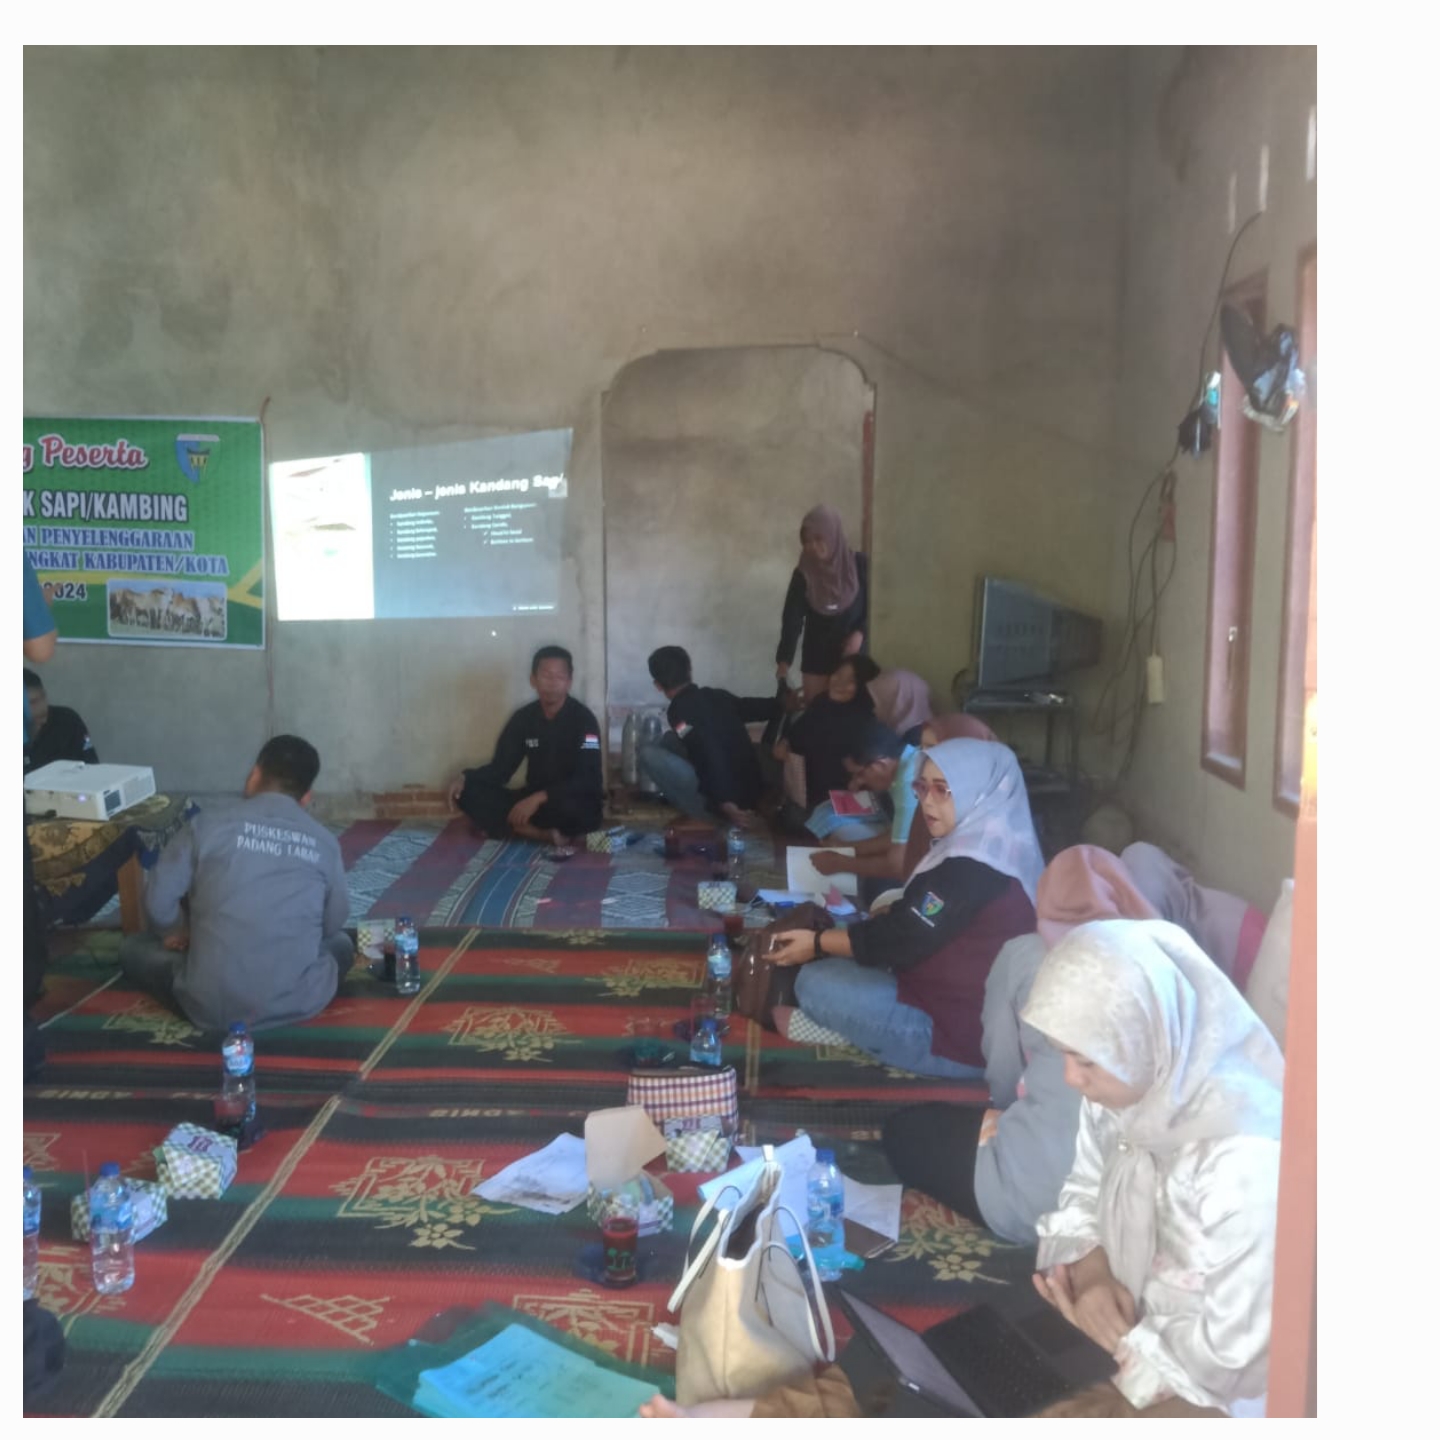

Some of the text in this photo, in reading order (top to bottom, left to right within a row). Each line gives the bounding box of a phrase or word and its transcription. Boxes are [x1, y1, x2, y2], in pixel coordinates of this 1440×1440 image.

[39, 434, 148, 468] Peserta
[469, 478, 529, 494] Kandang
[41, 491, 188, 522] SAPI/KAMBING
[42, 528, 193, 549] PENYELENGGARAAN
[85, 553, 228, 575] KABUPATEN/KOTA
[237, 835, 282, 856] PADANG
